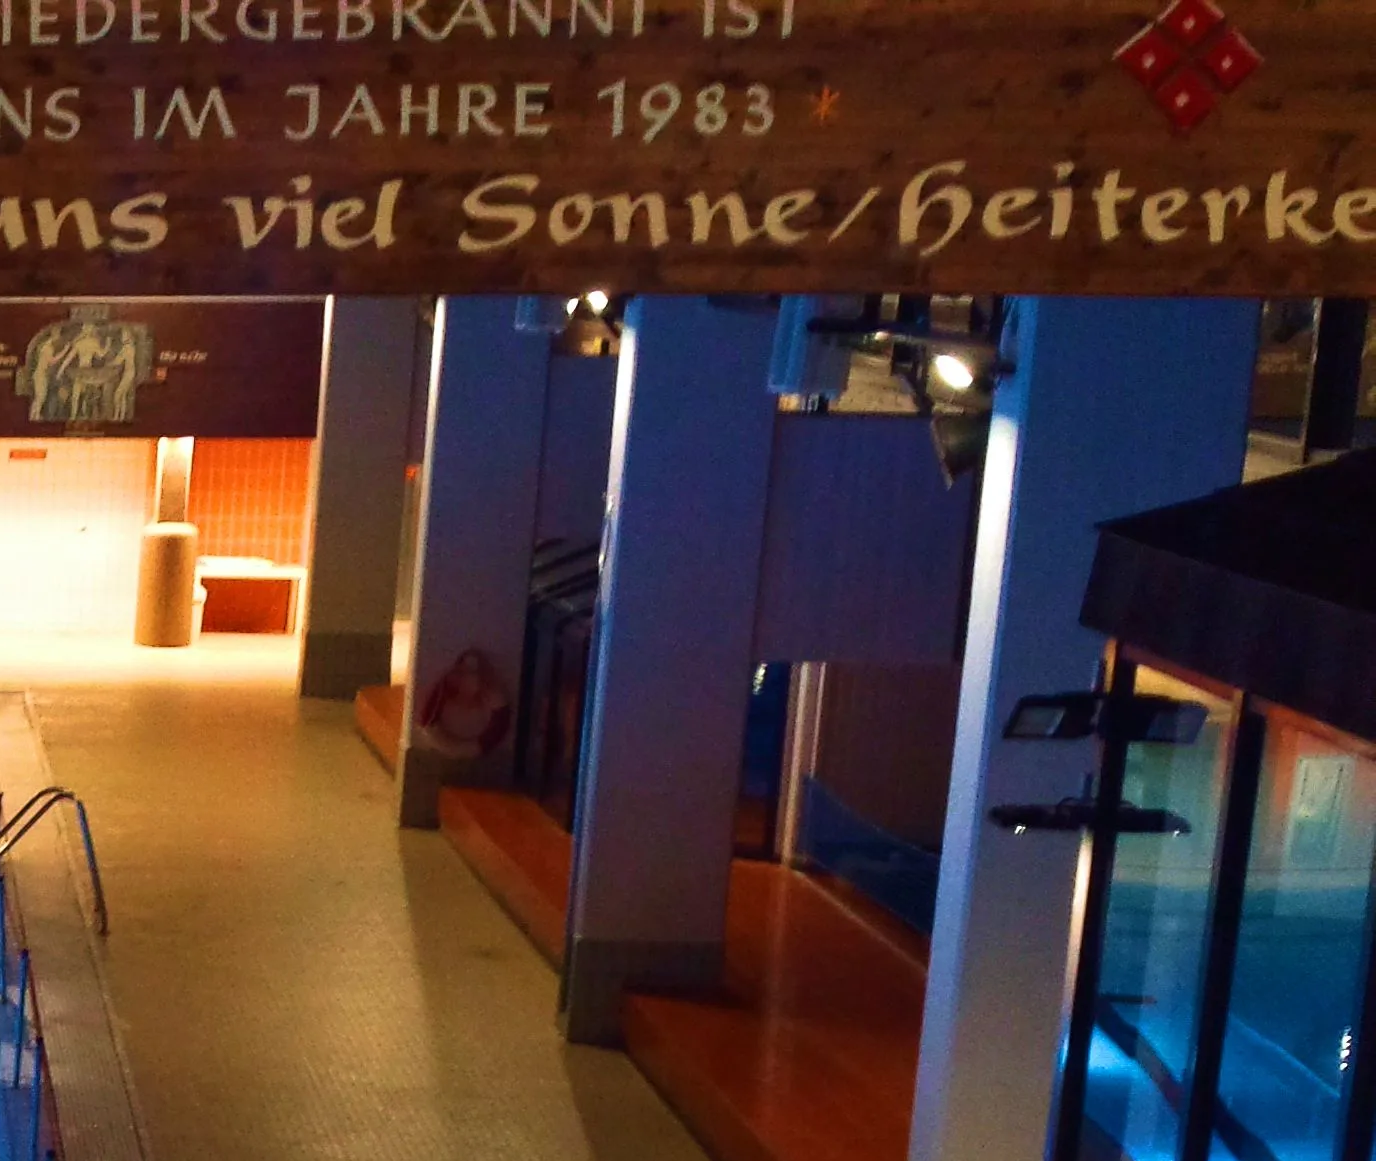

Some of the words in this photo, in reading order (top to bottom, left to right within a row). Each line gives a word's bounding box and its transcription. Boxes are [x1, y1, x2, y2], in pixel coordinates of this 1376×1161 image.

[701, 0, 796, 39] IST
[133, 87, 236, 140] IM
[284, 82, 552, 141] JAHRE
[598, 80, 776, 144] 1983
[223, 175, 402, 249] viel
